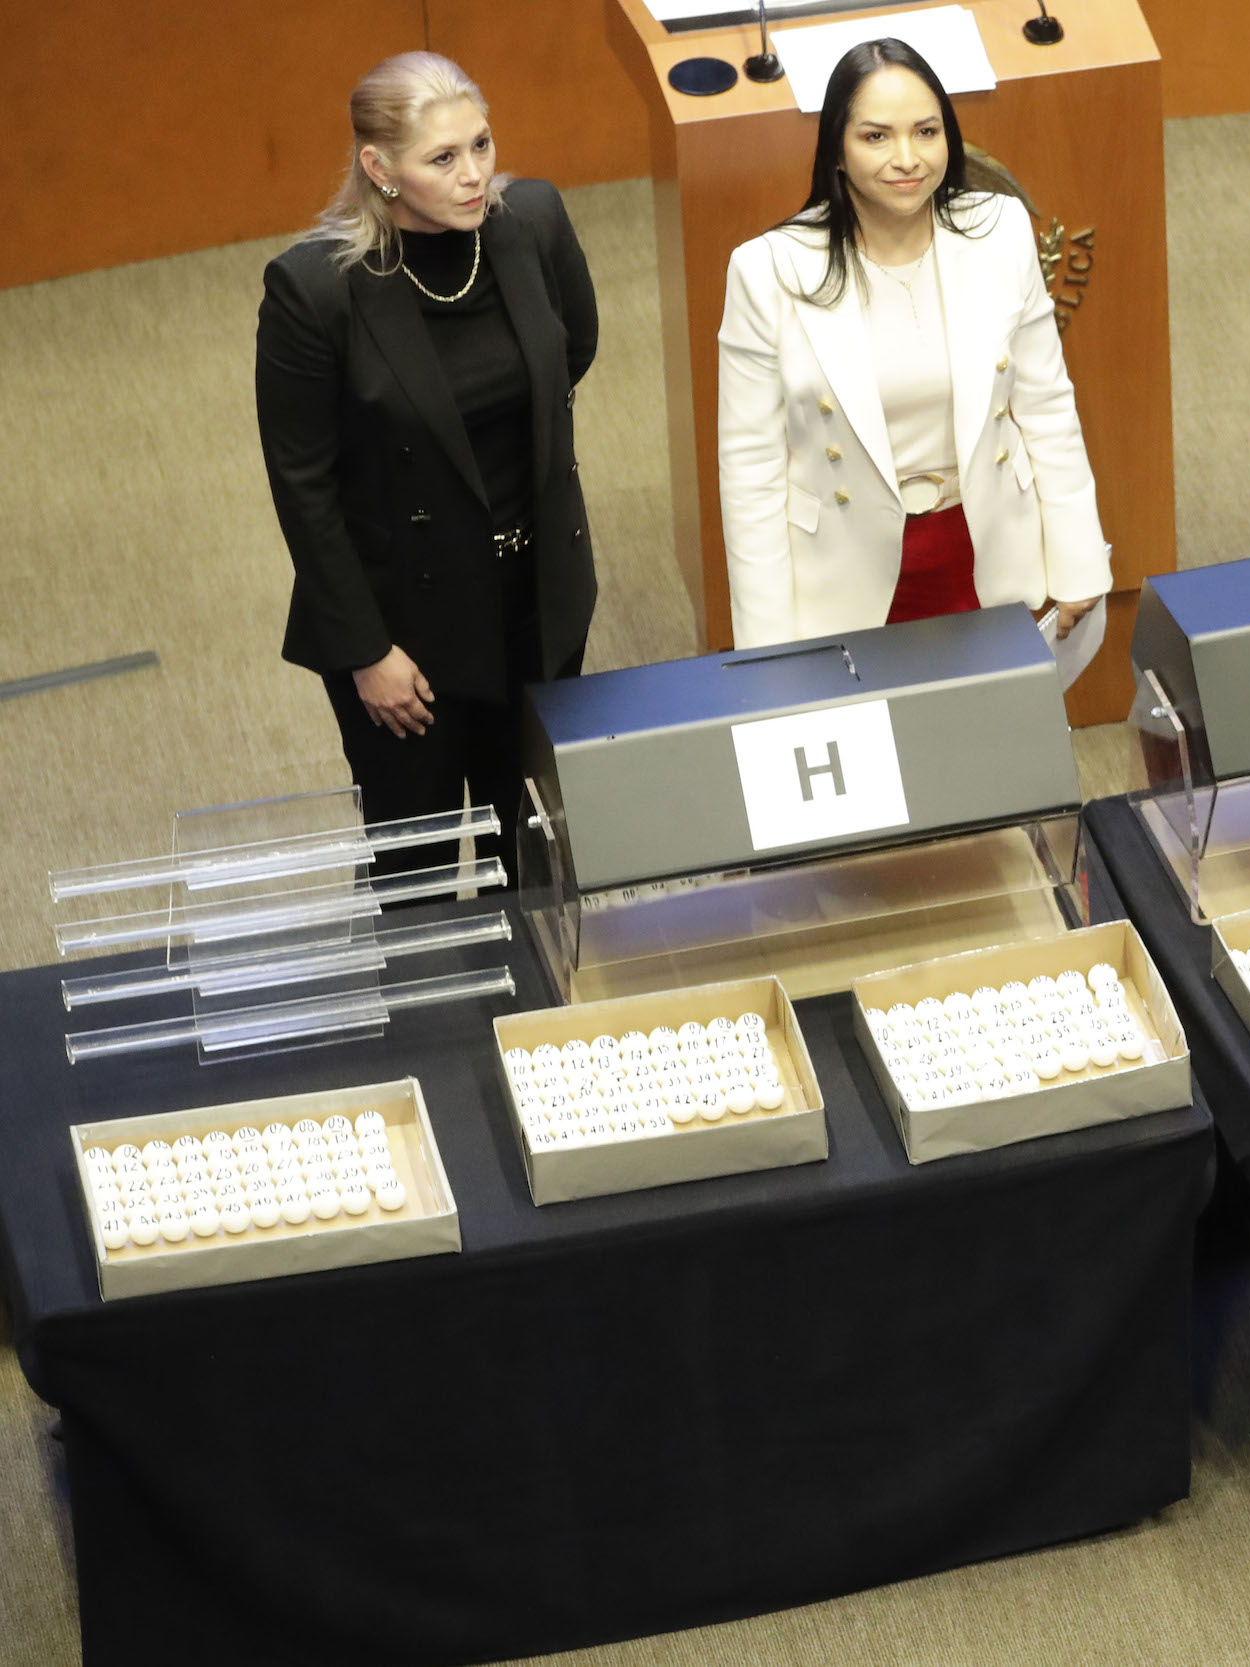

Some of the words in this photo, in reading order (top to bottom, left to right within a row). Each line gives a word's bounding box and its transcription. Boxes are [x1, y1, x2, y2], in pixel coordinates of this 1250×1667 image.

[794, 741, 848, 802] H
[703, 1093, 717, 1106] 43
[104, 1220, 119, 1231] 41
